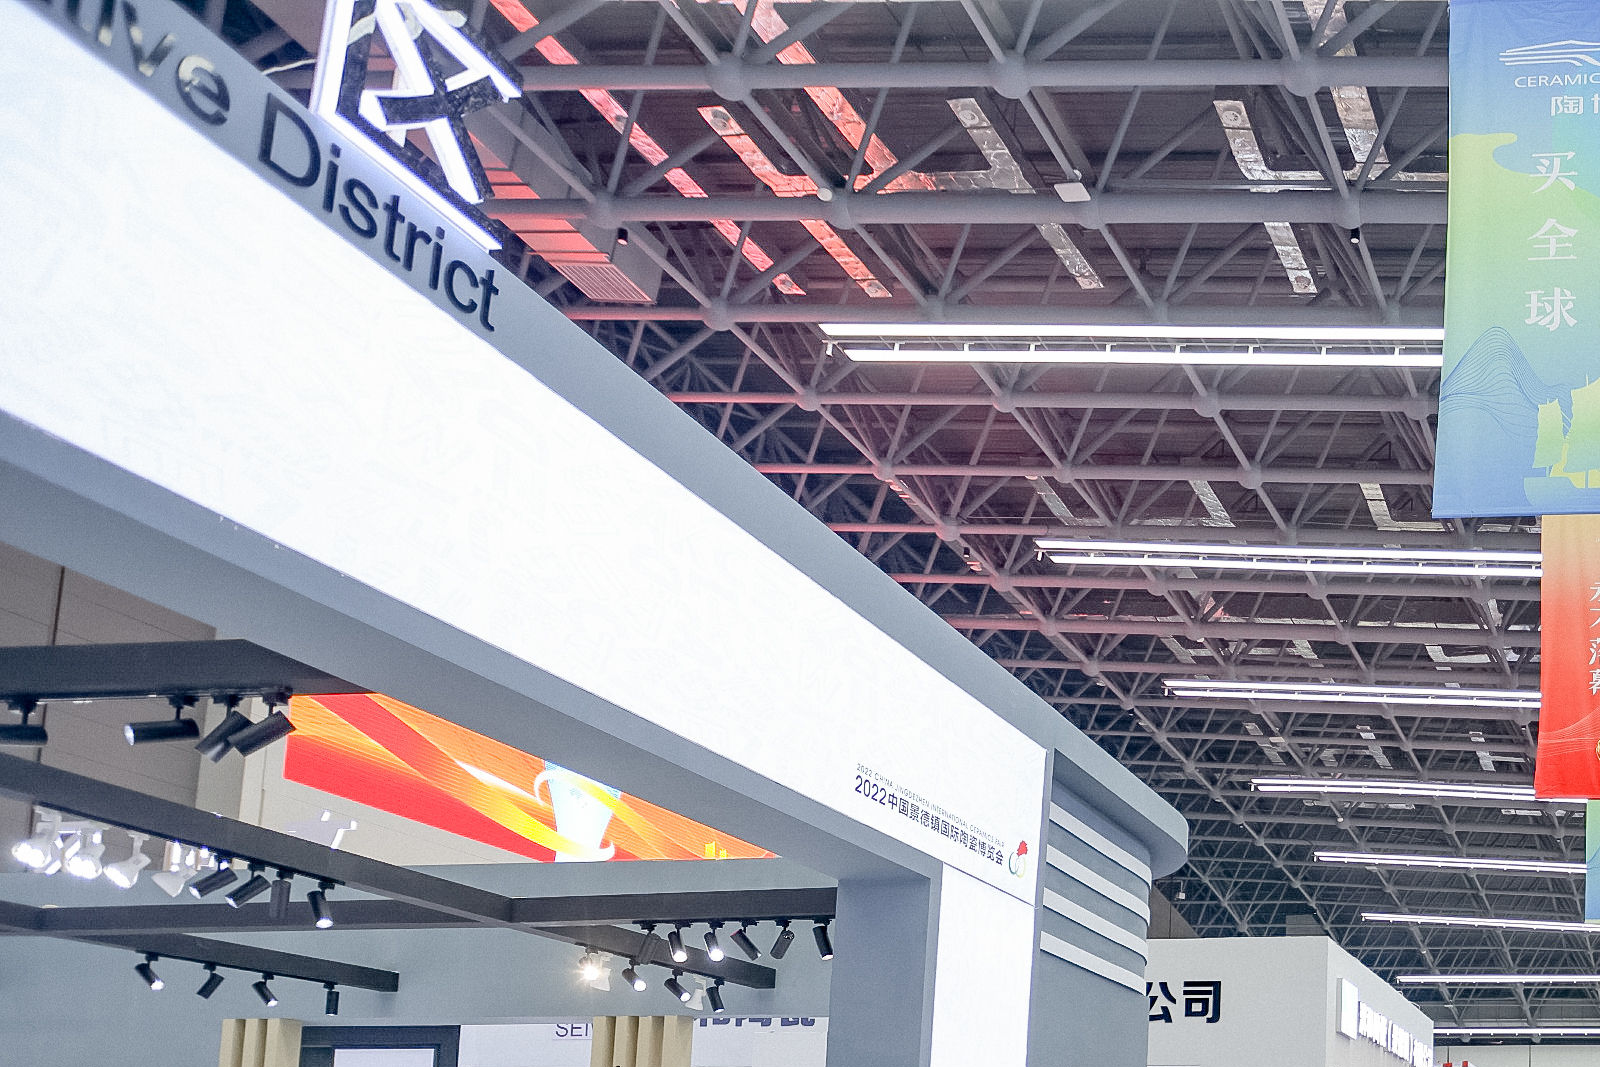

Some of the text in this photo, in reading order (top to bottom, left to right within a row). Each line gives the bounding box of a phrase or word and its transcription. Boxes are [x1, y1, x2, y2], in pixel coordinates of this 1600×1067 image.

[258, 92, 500, 333] District
[1524, 150, 1578, 331] 买全球
[1146, 980, 1222, 1024] 公司
